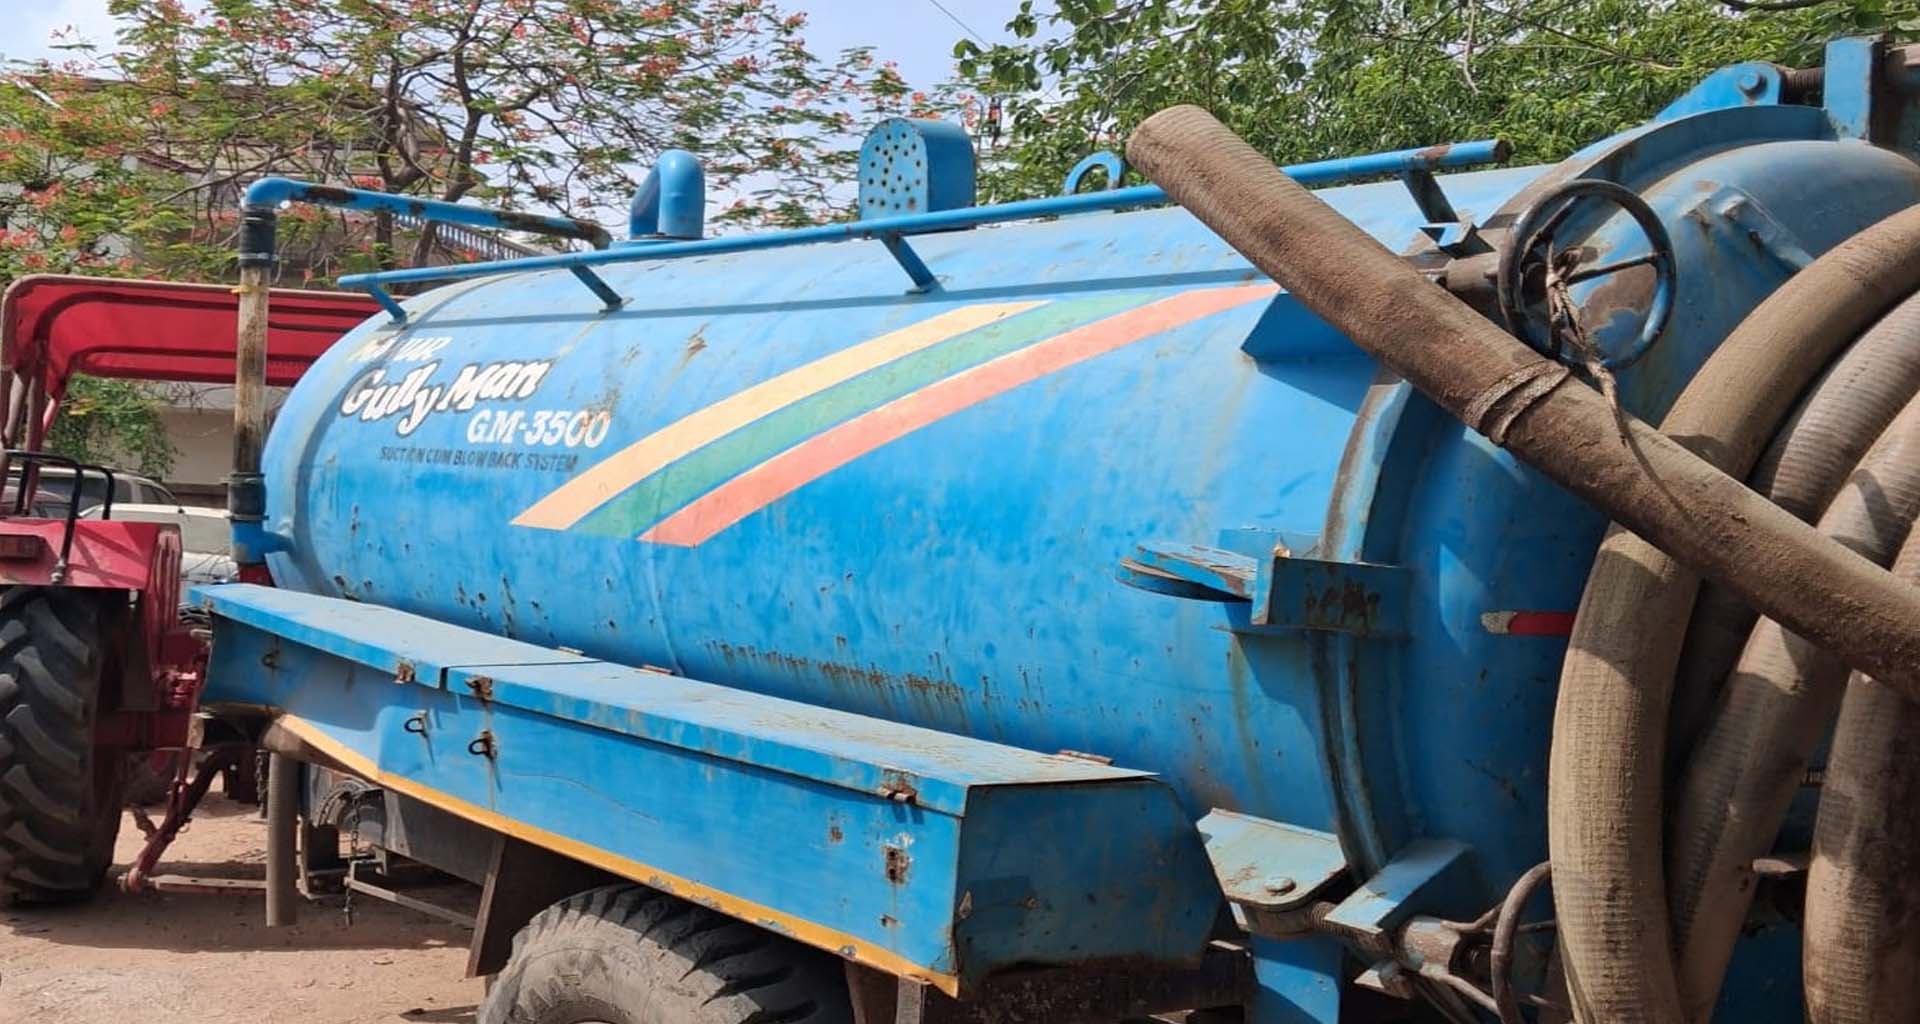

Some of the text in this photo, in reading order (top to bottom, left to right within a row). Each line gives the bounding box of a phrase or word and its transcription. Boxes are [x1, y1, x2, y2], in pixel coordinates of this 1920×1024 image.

[341, 361, 550, 435] Gully Man
[466, 409, 612, 448] GM-3500
[525, 453, 578, 473] SYSTEM
